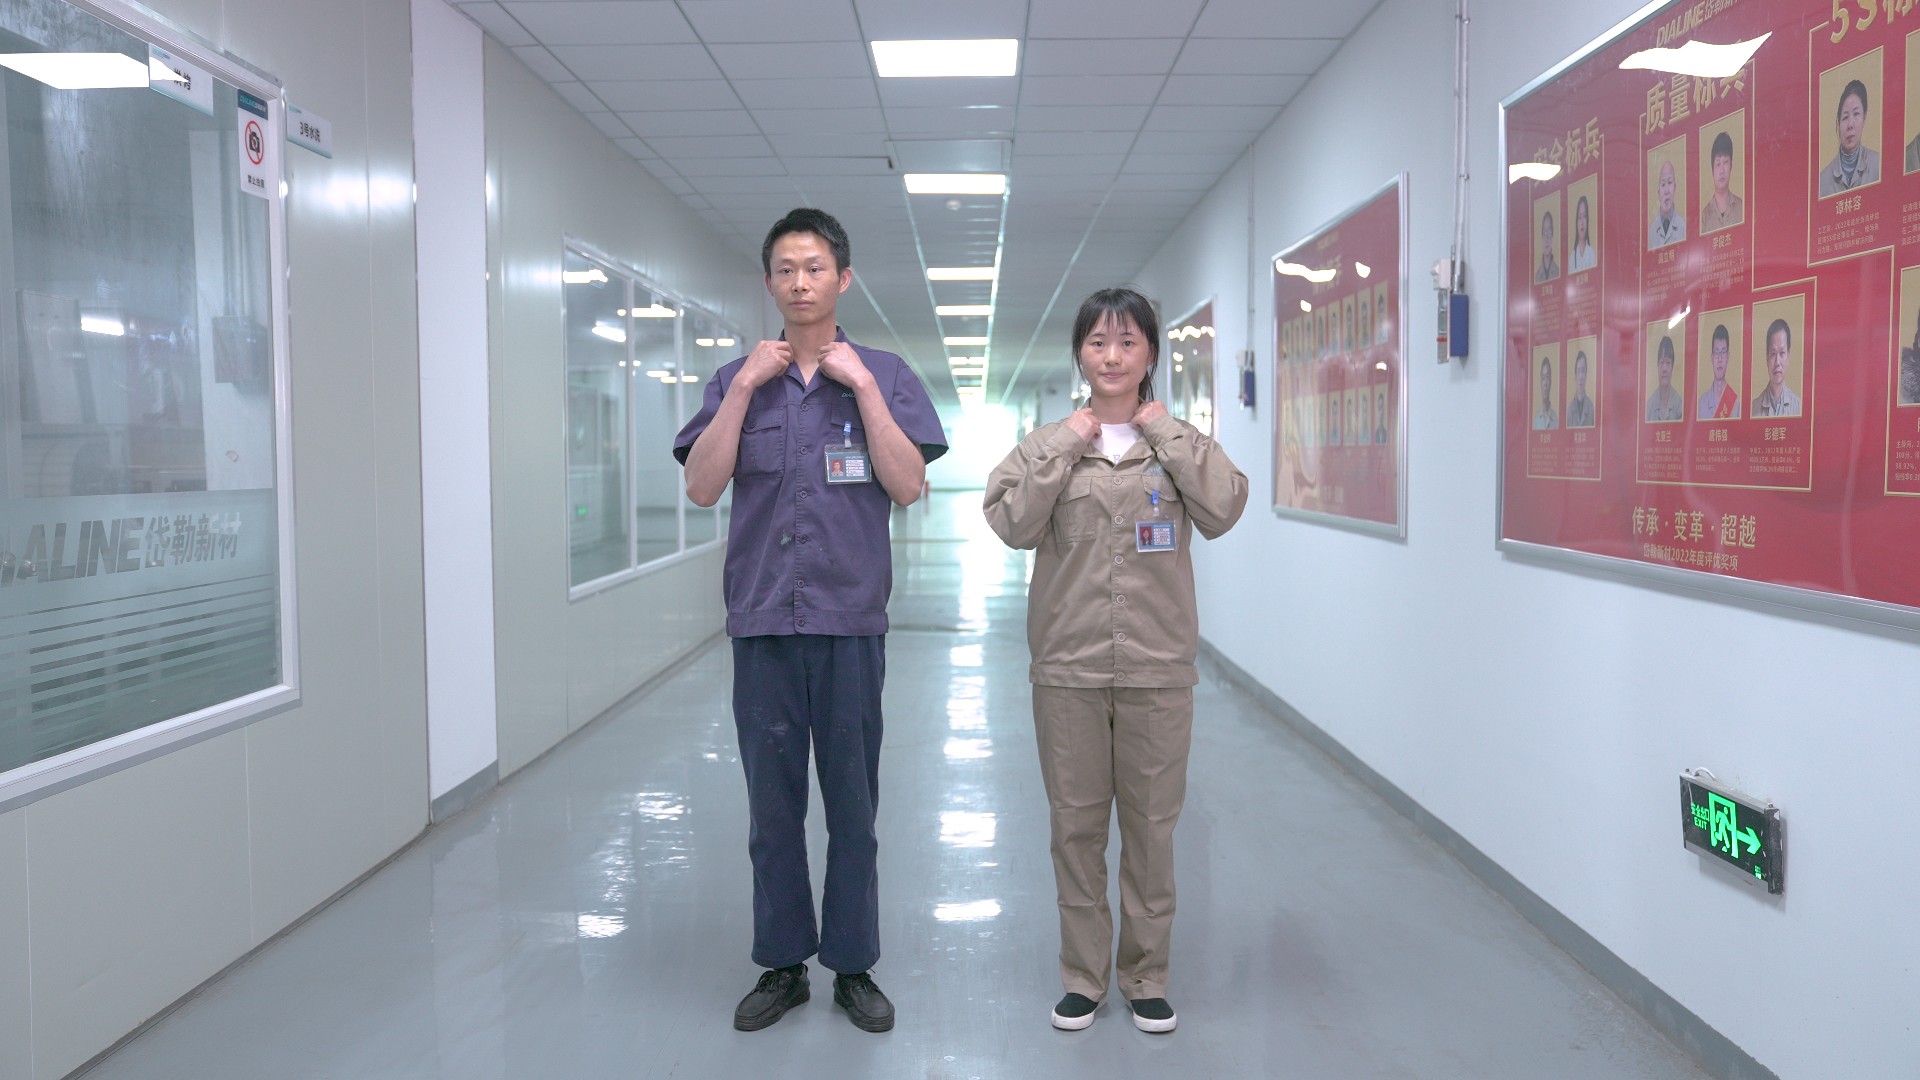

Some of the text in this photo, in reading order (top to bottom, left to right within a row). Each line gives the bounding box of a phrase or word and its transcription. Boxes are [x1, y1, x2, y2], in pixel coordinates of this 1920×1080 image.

[1655, 2, 1706, 49] DIALINE
[1830, 0, 1920, 44] 5S
[1764, 427, 1787, 441] 彭德军
[144, 512, 242, 568] 岱勒新材
[1643, 542, 1739, 571] 岱勒新材2022年度评优奖项
[1694, 820, 1708, 831] EXIT
